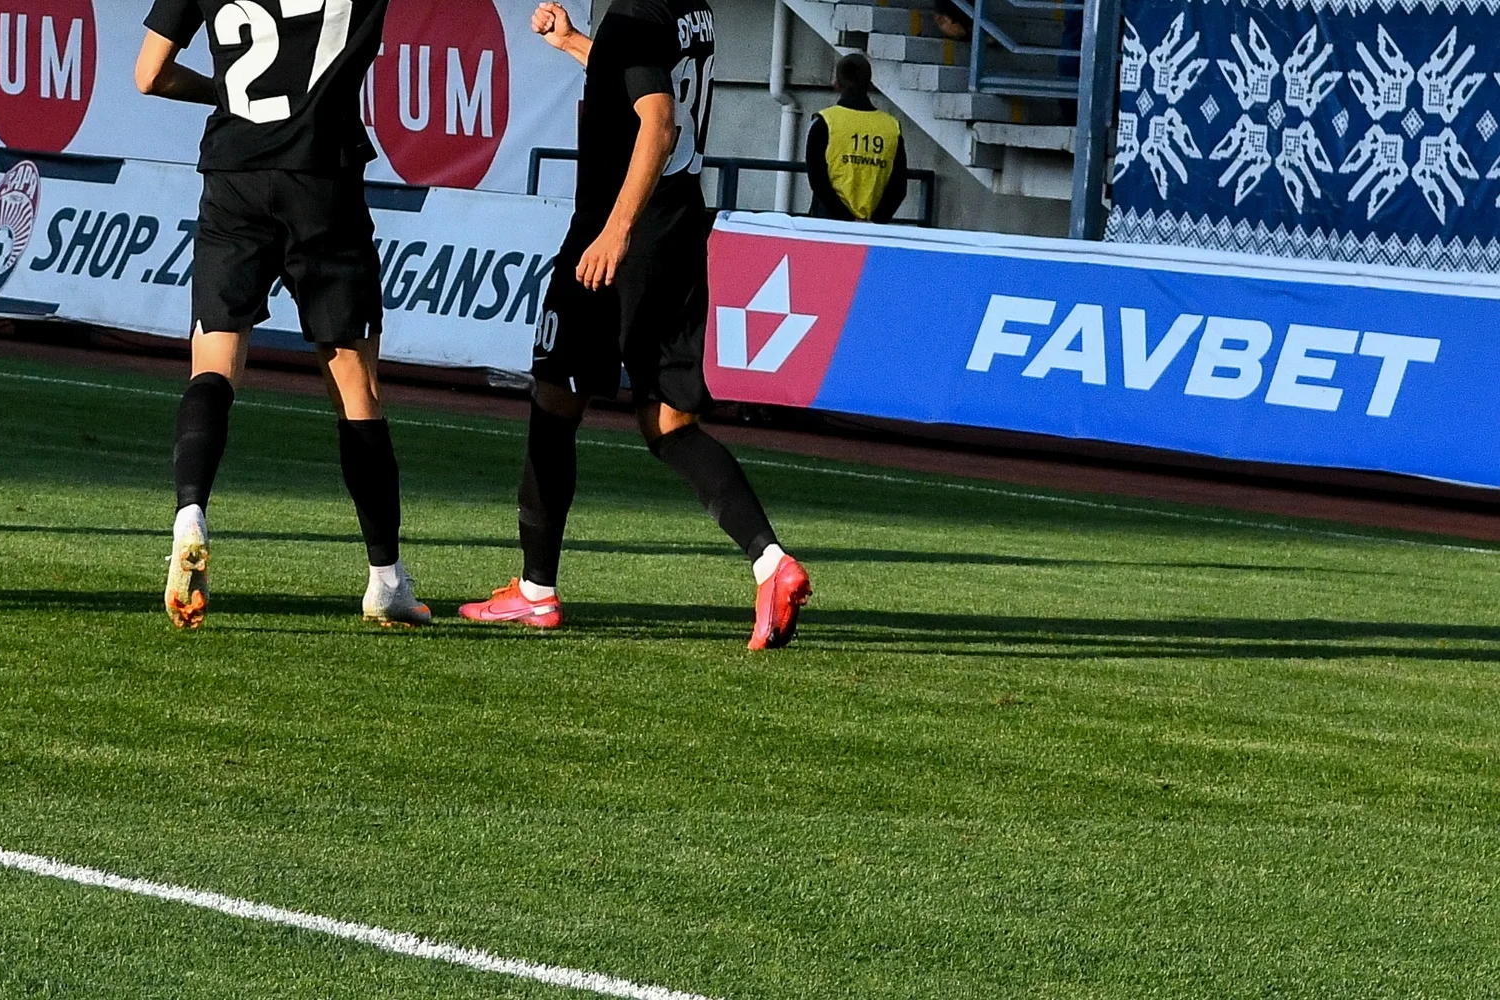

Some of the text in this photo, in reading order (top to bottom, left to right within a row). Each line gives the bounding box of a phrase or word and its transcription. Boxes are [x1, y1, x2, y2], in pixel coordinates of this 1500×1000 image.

[364, 42, 494, 138] UM
[841, 154, 887, 169] STEWARD
[851, 133, 884, 154] 119
[29, 207, 199, 287] SHOP.Z
[965, 293, 1442, 418] FAVBET
